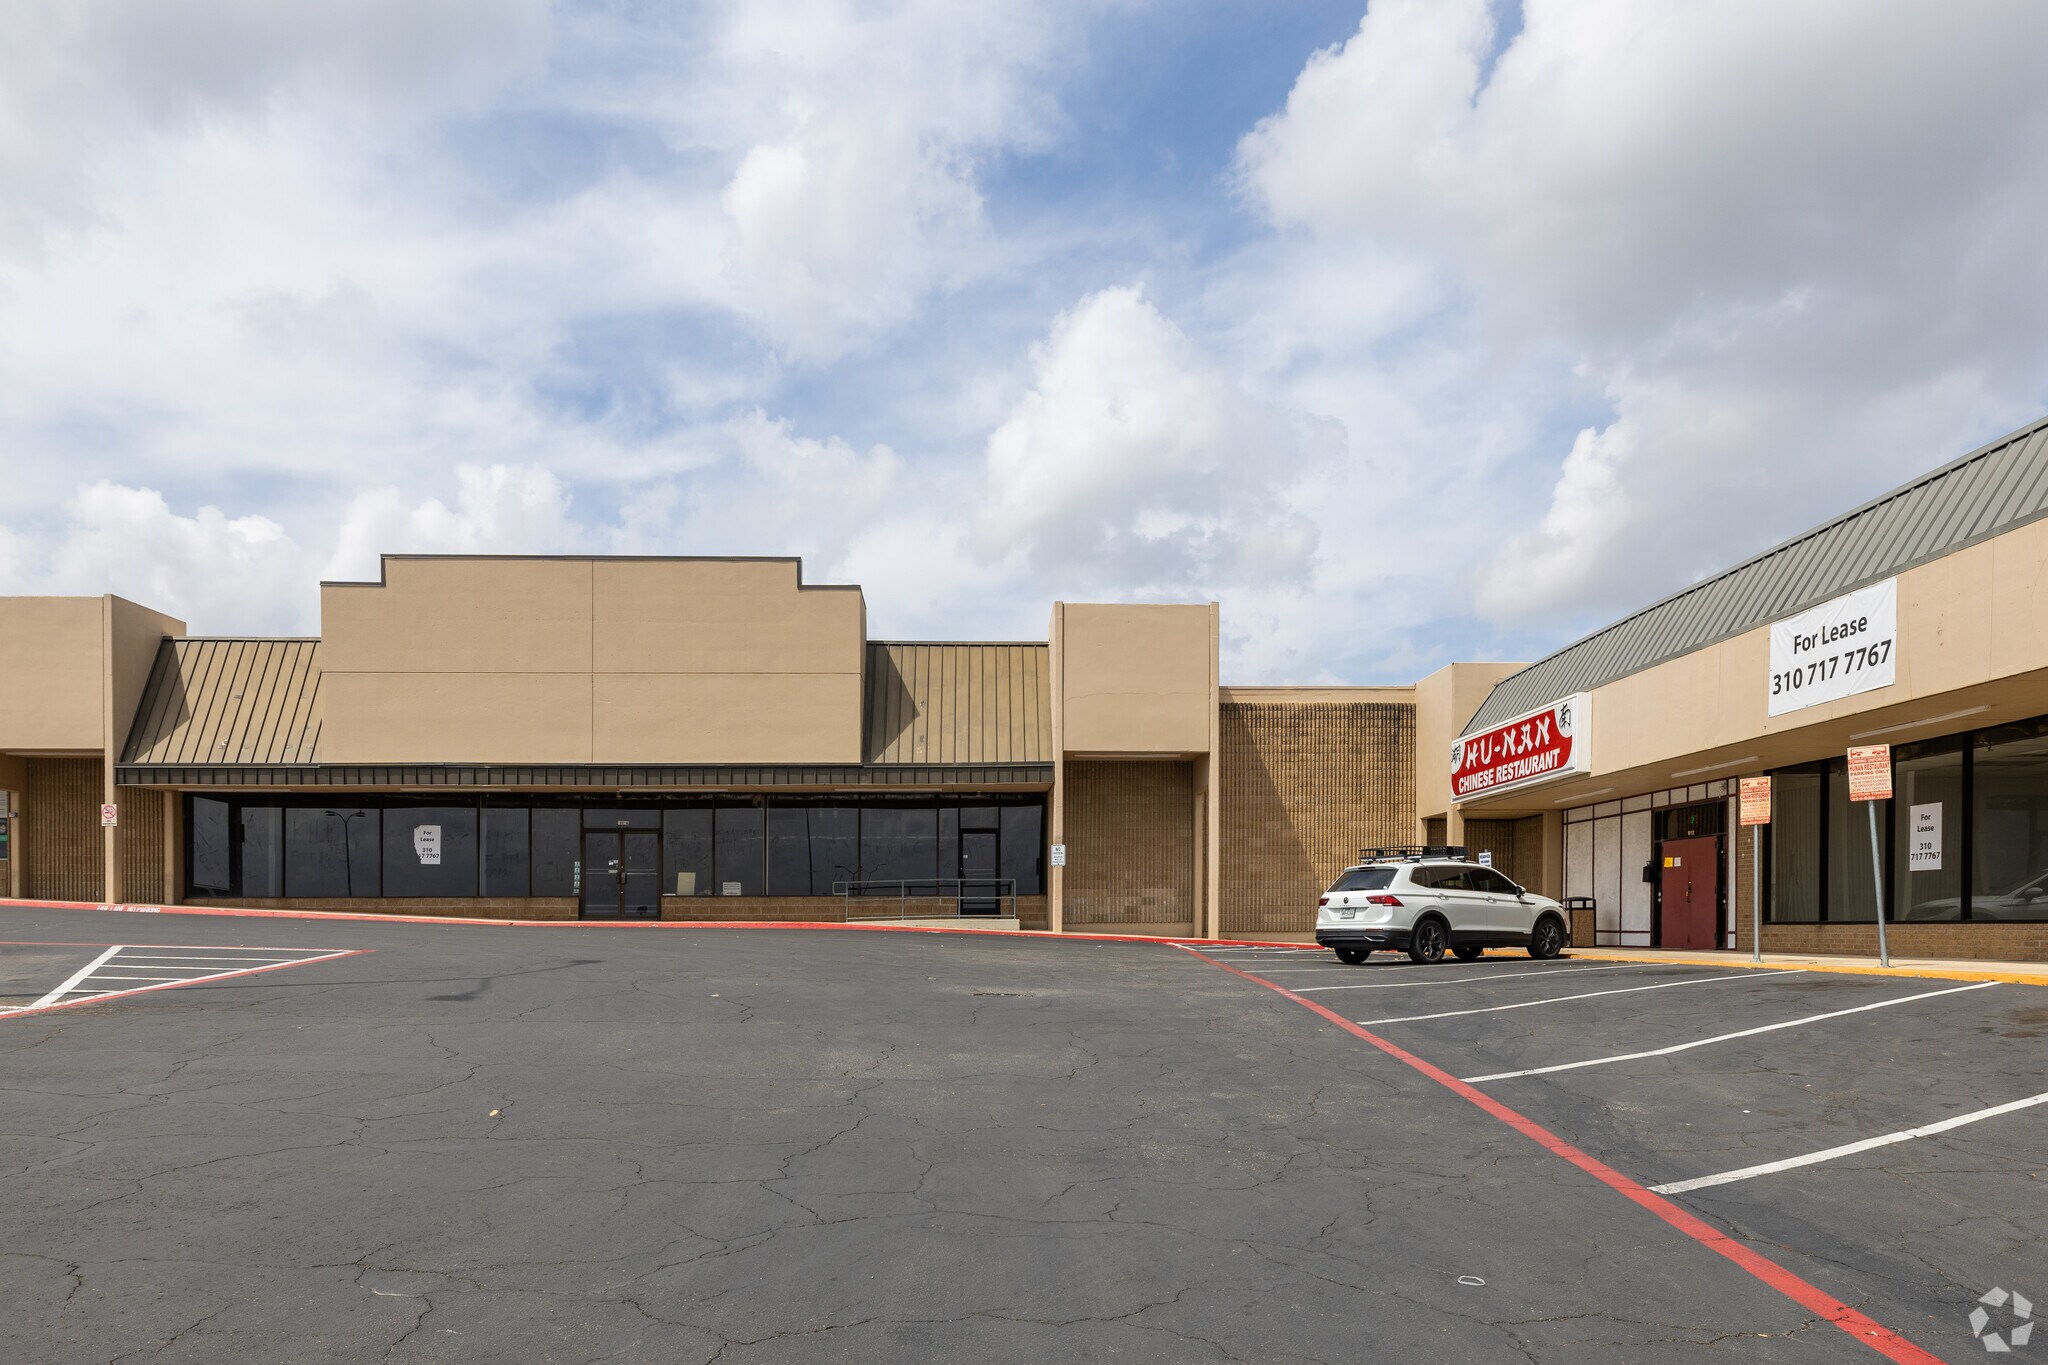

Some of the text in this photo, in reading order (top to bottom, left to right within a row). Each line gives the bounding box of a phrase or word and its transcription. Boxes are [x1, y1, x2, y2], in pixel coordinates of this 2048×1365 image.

[1793, 616, 1868, 655] For Lease
[1772, 639, 1892, 695] 310 717 7767
[1465, 715, 1551, 770] HU-NAN
[1458, 748, 1561, 794] CHINESE RESTAURANT
[1863, 762, 1890, 770] RESTAURANT
[1920, 813, 1931, 821] For
[1917, 825, 1935, 833] Lease
[1919, 842, 1932, 850] 310
[1911, 851, 1941, 861] 717 7767
